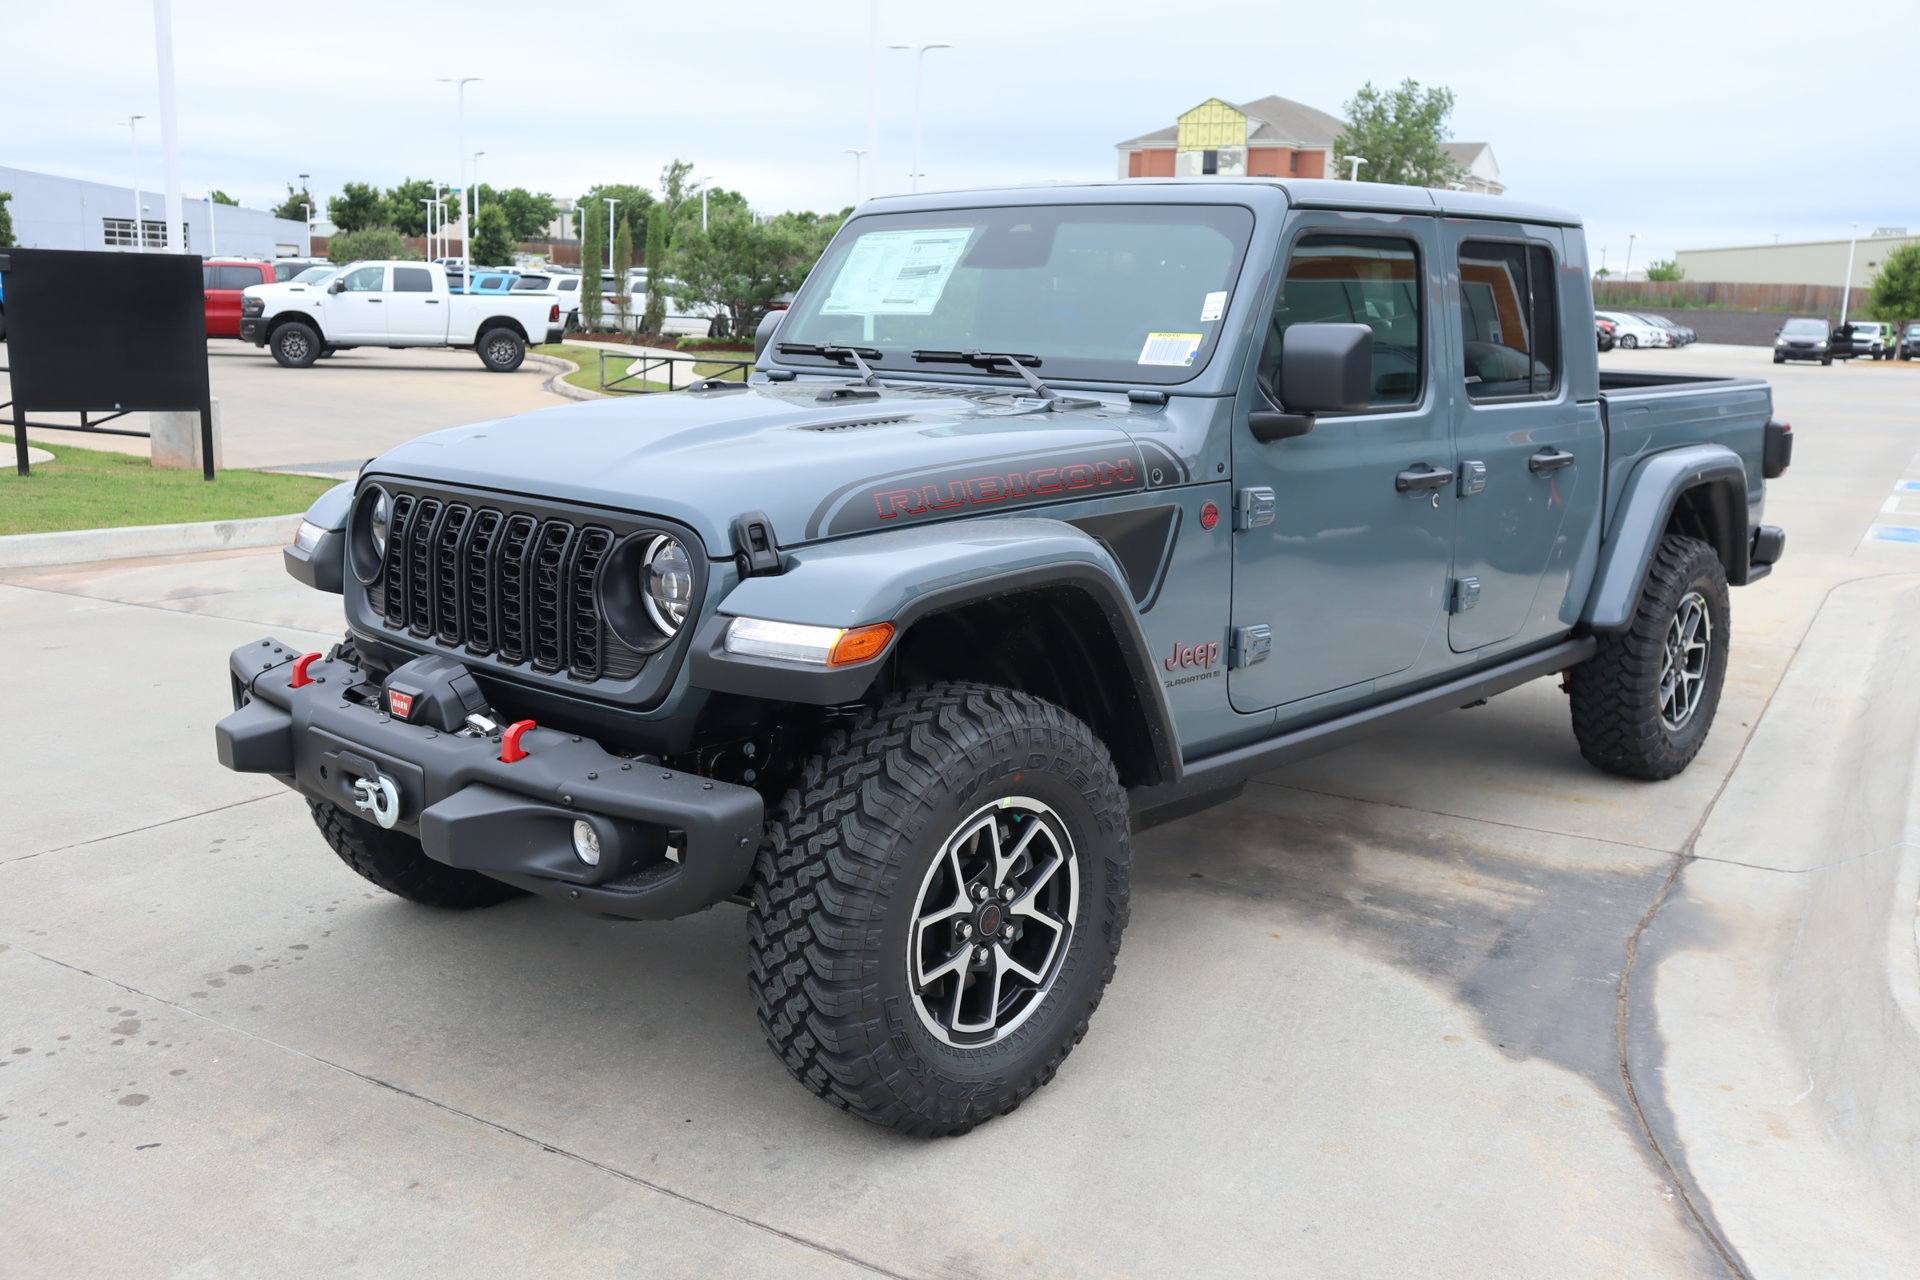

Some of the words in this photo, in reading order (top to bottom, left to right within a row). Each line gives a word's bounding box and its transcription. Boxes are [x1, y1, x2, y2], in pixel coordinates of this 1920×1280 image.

[874, 458, 1134, 519] RUBICON
[1165, 641, 1219, 671] Jeep
[956, 752, 1115, 835] WILDPEAK
